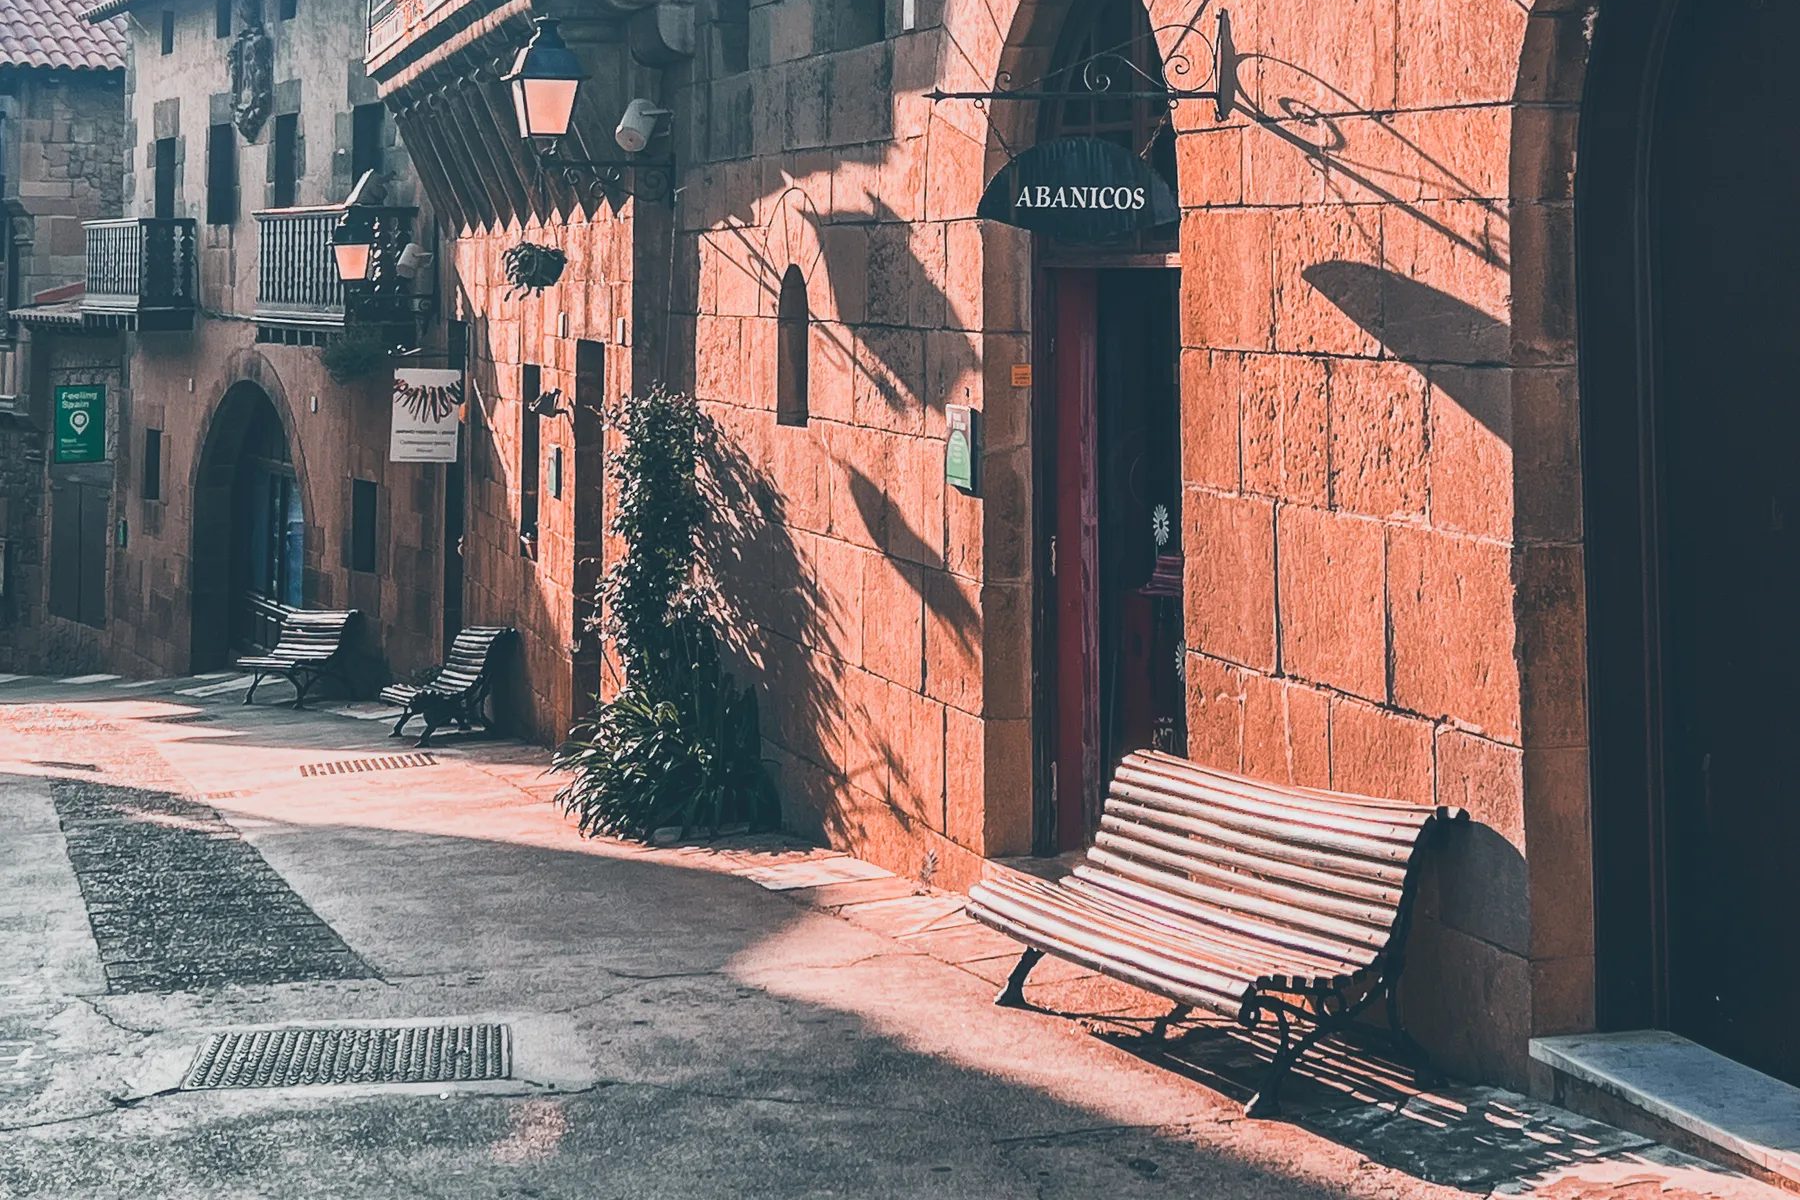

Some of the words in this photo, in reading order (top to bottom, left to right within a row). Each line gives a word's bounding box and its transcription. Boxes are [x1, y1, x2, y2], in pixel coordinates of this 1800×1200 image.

[1015, 185, 1145, 210] ABANICOS
[61, 392, 98, 401] Feeling
[61, 400, 90, 409] Spain
